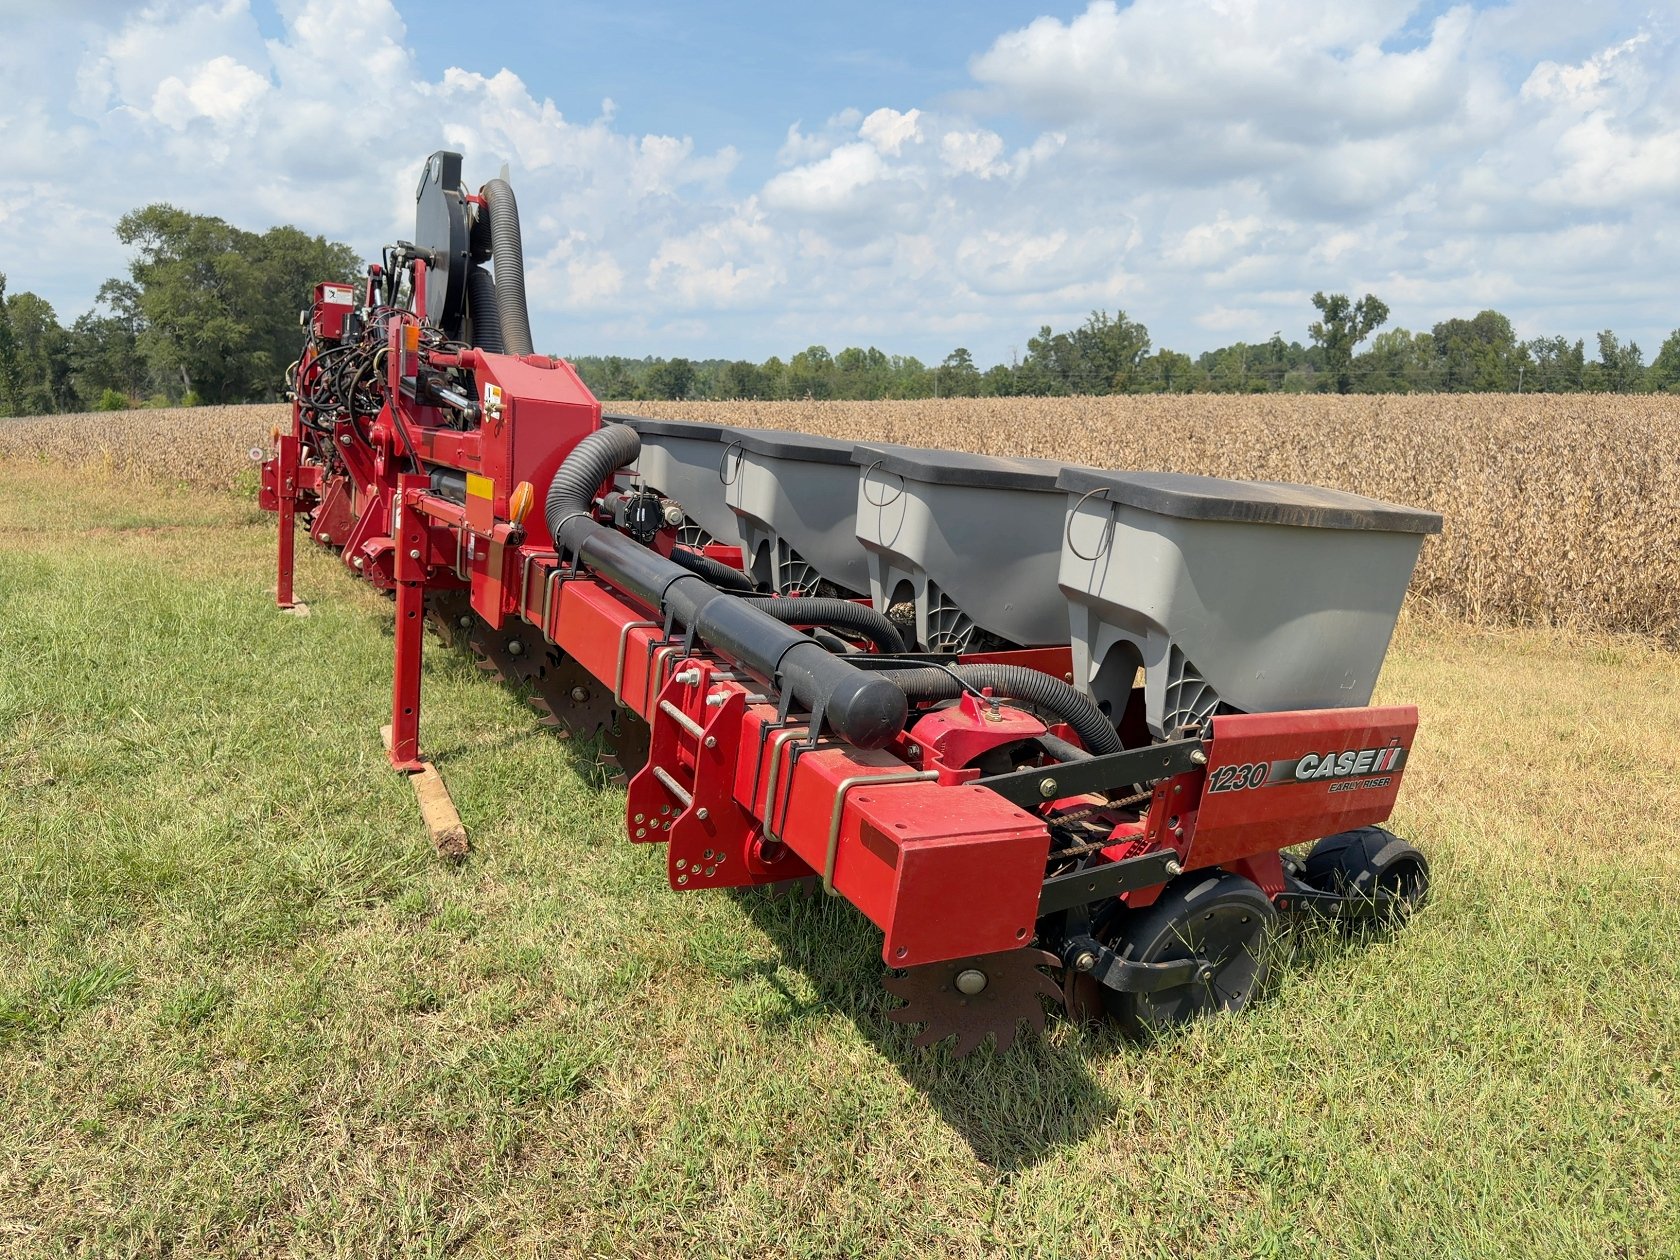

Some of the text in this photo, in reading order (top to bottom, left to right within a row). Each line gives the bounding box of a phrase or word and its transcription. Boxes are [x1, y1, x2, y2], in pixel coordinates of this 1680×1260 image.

[1208, 762, 1269, 794] 1230
[1295, 751, 1376, 780] CASE
[1328, 777, 1392, 793] EARLY RISER
